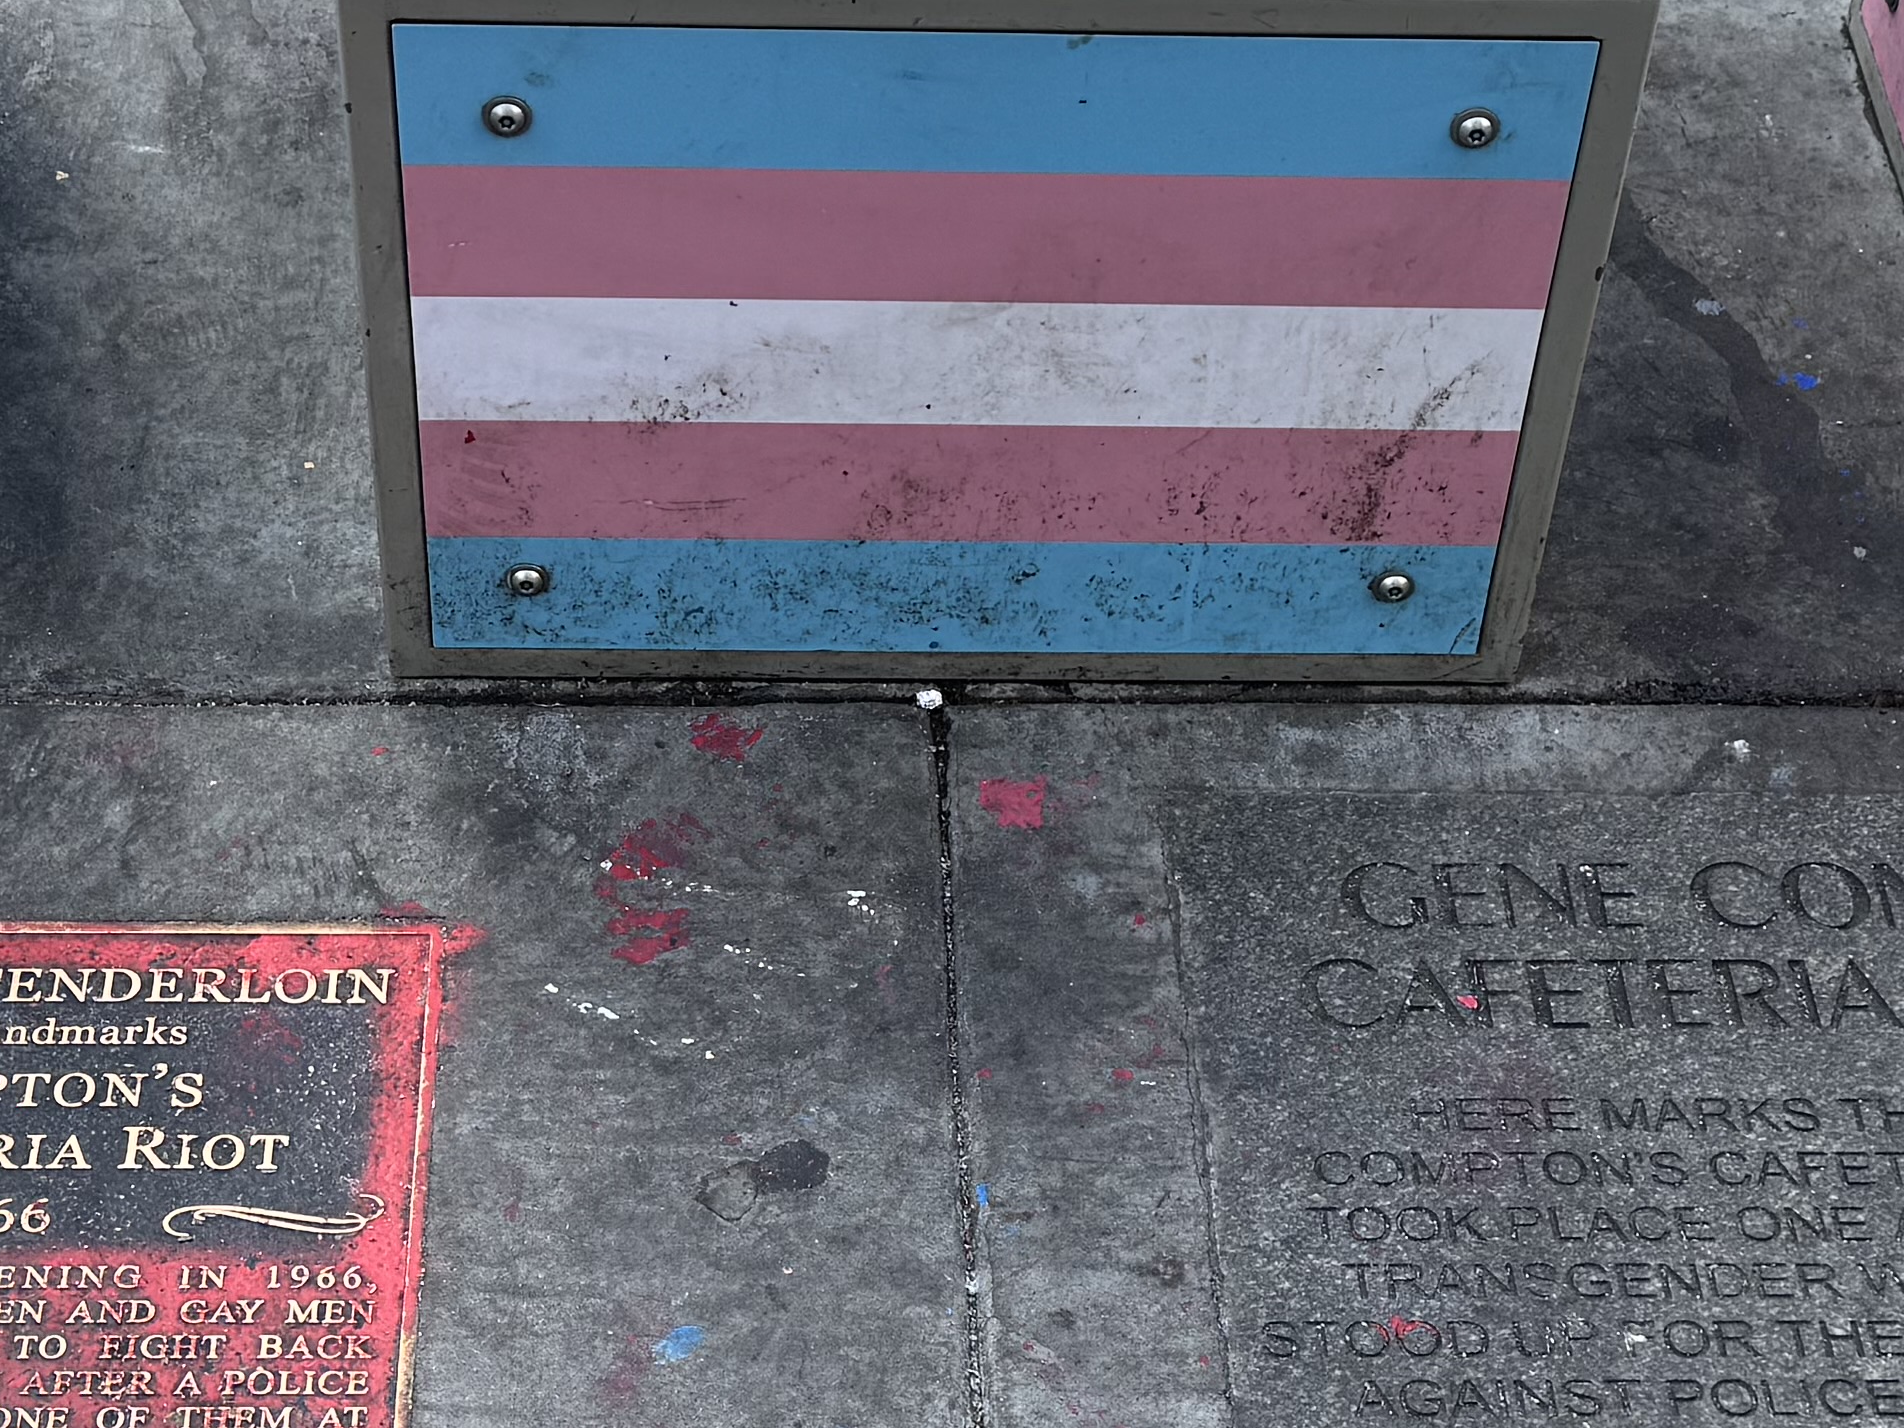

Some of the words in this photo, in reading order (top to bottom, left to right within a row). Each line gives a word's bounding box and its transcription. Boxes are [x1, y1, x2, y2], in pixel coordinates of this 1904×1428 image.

[1340, 862, 1645, 930] GENE
[1301, 958, 1904, 1030] CAFETERIA
[1409, 1098, 1581, 1132] HERE
[1601, 1098, 1821, 1132] MARKS
[118, 1127, 290, 1171] RIOT
[1314, 1151, 1690, 1186] COMPTON'S
[1305, 1206, 1488, 1241] TOOK
[1507, 1206, 1708, 1241] PLACE
[1738, 1206, 1871, 1241] ONE
[178, 1265, 227, 1291] IN
[264, 1263, 379, 1294] 1966,
[1342, 1263, 1841, 1300] TRANSGENDER
[67, 1299, 157, 1326] AND
[180, 1299, 264, 1325] GAY
[284, 1299, 376, 1325] MEN
[14, 1334, 67, 1361] TO
[95, 1334, 227, 1360] FIGHT
[258, 1334, 373, 1360] BACK
[1261, 1321, 1490, 1357] STOOD
[1514, 1320, 1596, 1357] UP
[1621, 1321, 1762, 1357] FOR
[19, 1370, 156, 1397] AFTER
[172, 1370, 200, 1396] A
[220, 1369, 371, 1396] POLICE
[1355, 1380, 1641, 1417] AGAINST
